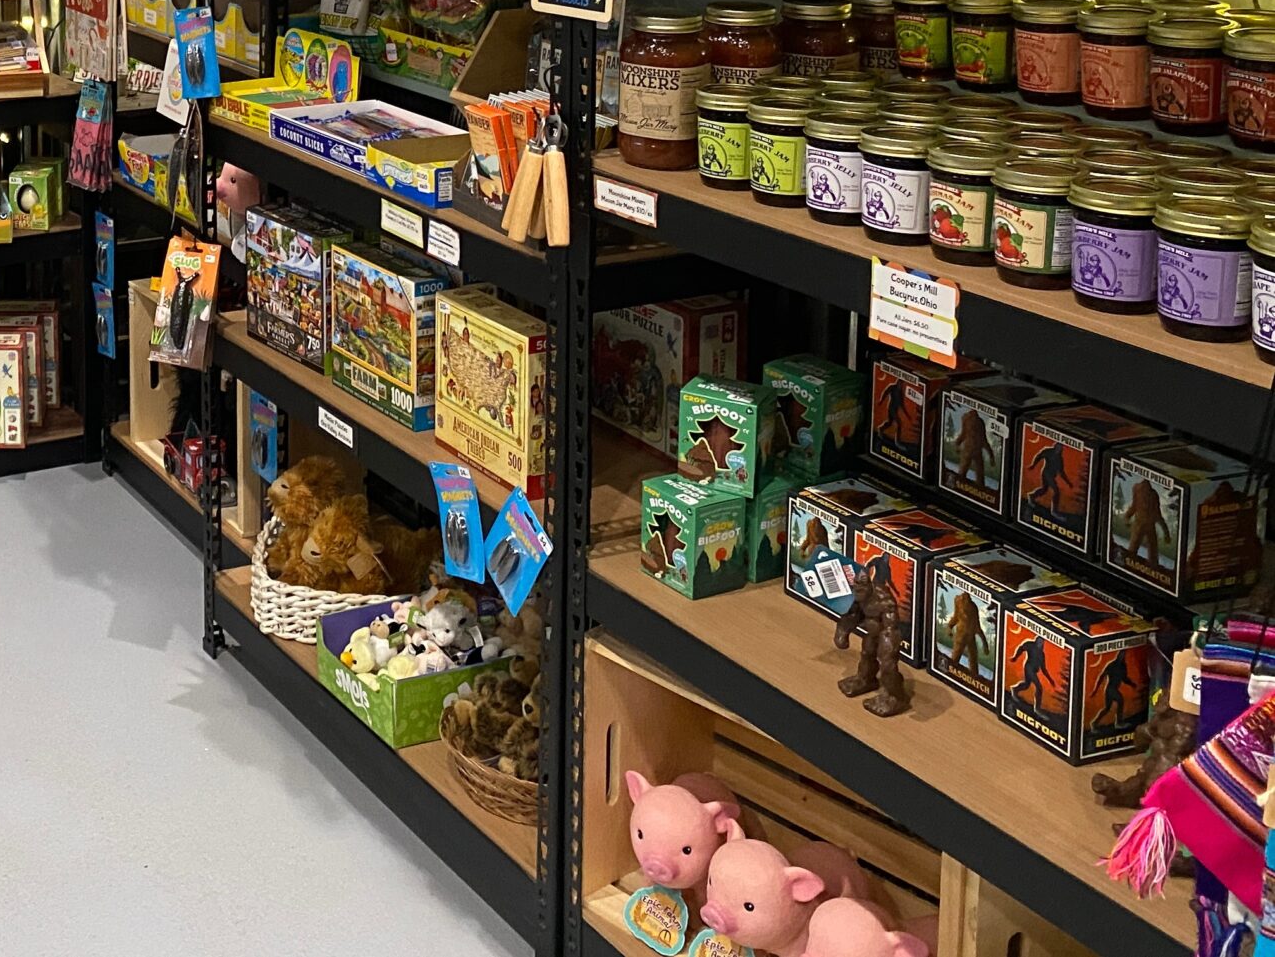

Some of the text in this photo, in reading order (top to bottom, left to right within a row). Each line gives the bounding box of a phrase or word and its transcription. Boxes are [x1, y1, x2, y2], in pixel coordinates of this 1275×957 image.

[621, 61, 681, 78] MOONSHINE
[621, 72, 680, 91] MIXERS
[280, 127, 324, 153] COCONUT SLICES
[833, 162, 856, 179] JELLY
[889, 179, 913, 199] JELLY
[174, 257, 200, 268] SLUG
[420, 282, 443, 293] 1000
[891, 273, 938, 296] Cooper's Mill
[307, 335, 320, 349] 750
[353, 367, 376, 386] FARM
[391, 387, 413, 413] 1000
[683, 395, 706, 404] GROW
[771, 380, 814, 403] BIGFOOT
[692, 404, 747, 425] BIGFOOT
[453, 417, 499, 454] AMERICAN INDIAN
[466, 440, 485, 460] TRIBES
[881, 445, 919, 470] BIGFOOT
[508, 452, 522, 471] 500
[649, 498, 688, 524] BIGFOOT
[698, 528, 741, 546] BIGFOOT
[1032, 514, 1084, 544] BIGFOOT
[864, 531, 907, 561] 300 PIECE PUZZLE
[944, 572, 990, 600] 300 PIECE PUZZLE
[1016, 613, 1063, 646] 300 PIECE PUZZLE
[1028, 604, 1080, 637] BIGFOOT
[948, 665, 990, 695] SASQUATCH
[1016, 709, 1066, 744] BIGFOOT
[642, 896, 661, 909] Epic
[647, 907, 671, 929] Animal
